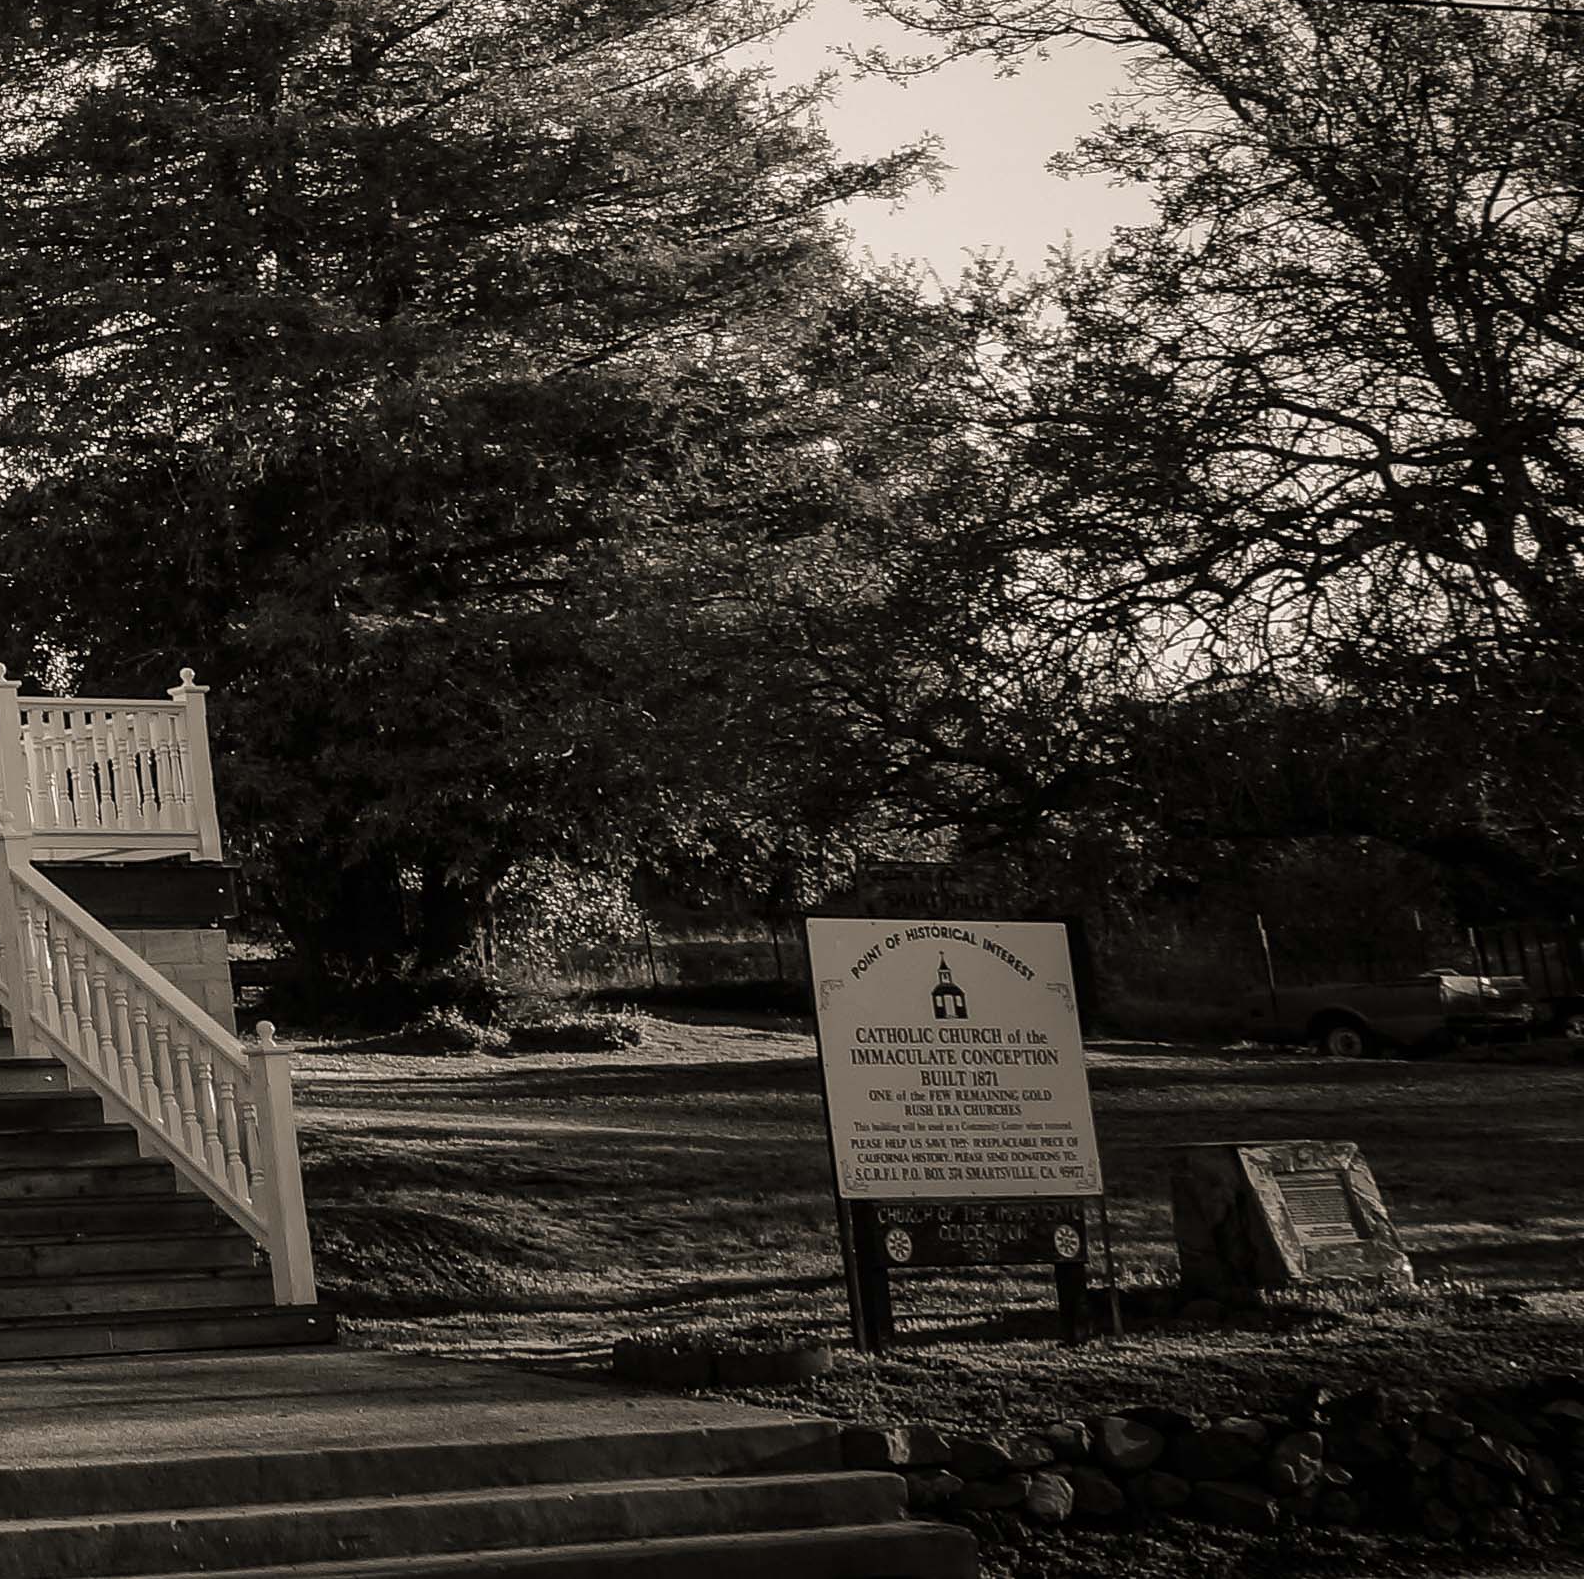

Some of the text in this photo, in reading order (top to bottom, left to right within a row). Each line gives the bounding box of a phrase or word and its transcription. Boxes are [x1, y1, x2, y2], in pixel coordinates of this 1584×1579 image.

[850, 925, 1036, 981] POINT OF HISTORICAL INTEREST
[855, 1027, 1048, 1044] CATHOLIC CHURCH of the
[850, 1048, 1059, 1065] IMMACULATE CONCEPTION
[920, 1070, 999, 1087] BUILT 1871
[869, 1090, 1052, 1102] ONE of the FEW REMAINING GOLD
[905, 1104, 1022, 1117] RUSH ERA CHURCHES
[850, 1136, 1079, 1149] PLEASE HELP US SAVE THIS IRREPLACEABLE PIECE OF
[857, 1152, 909, 1164] CALIFORNIA
[954, 1152, 983, 1164] PLEASE
[986, 1152, 1009, 1163] SEND
[1011, 1151, 1060, 1163] DONATIONS
[925, 1167, 945, 1181] BOX
[877, 1207, 932, 1224] CHURCH
[938, 1206, 952, 1222] OF
